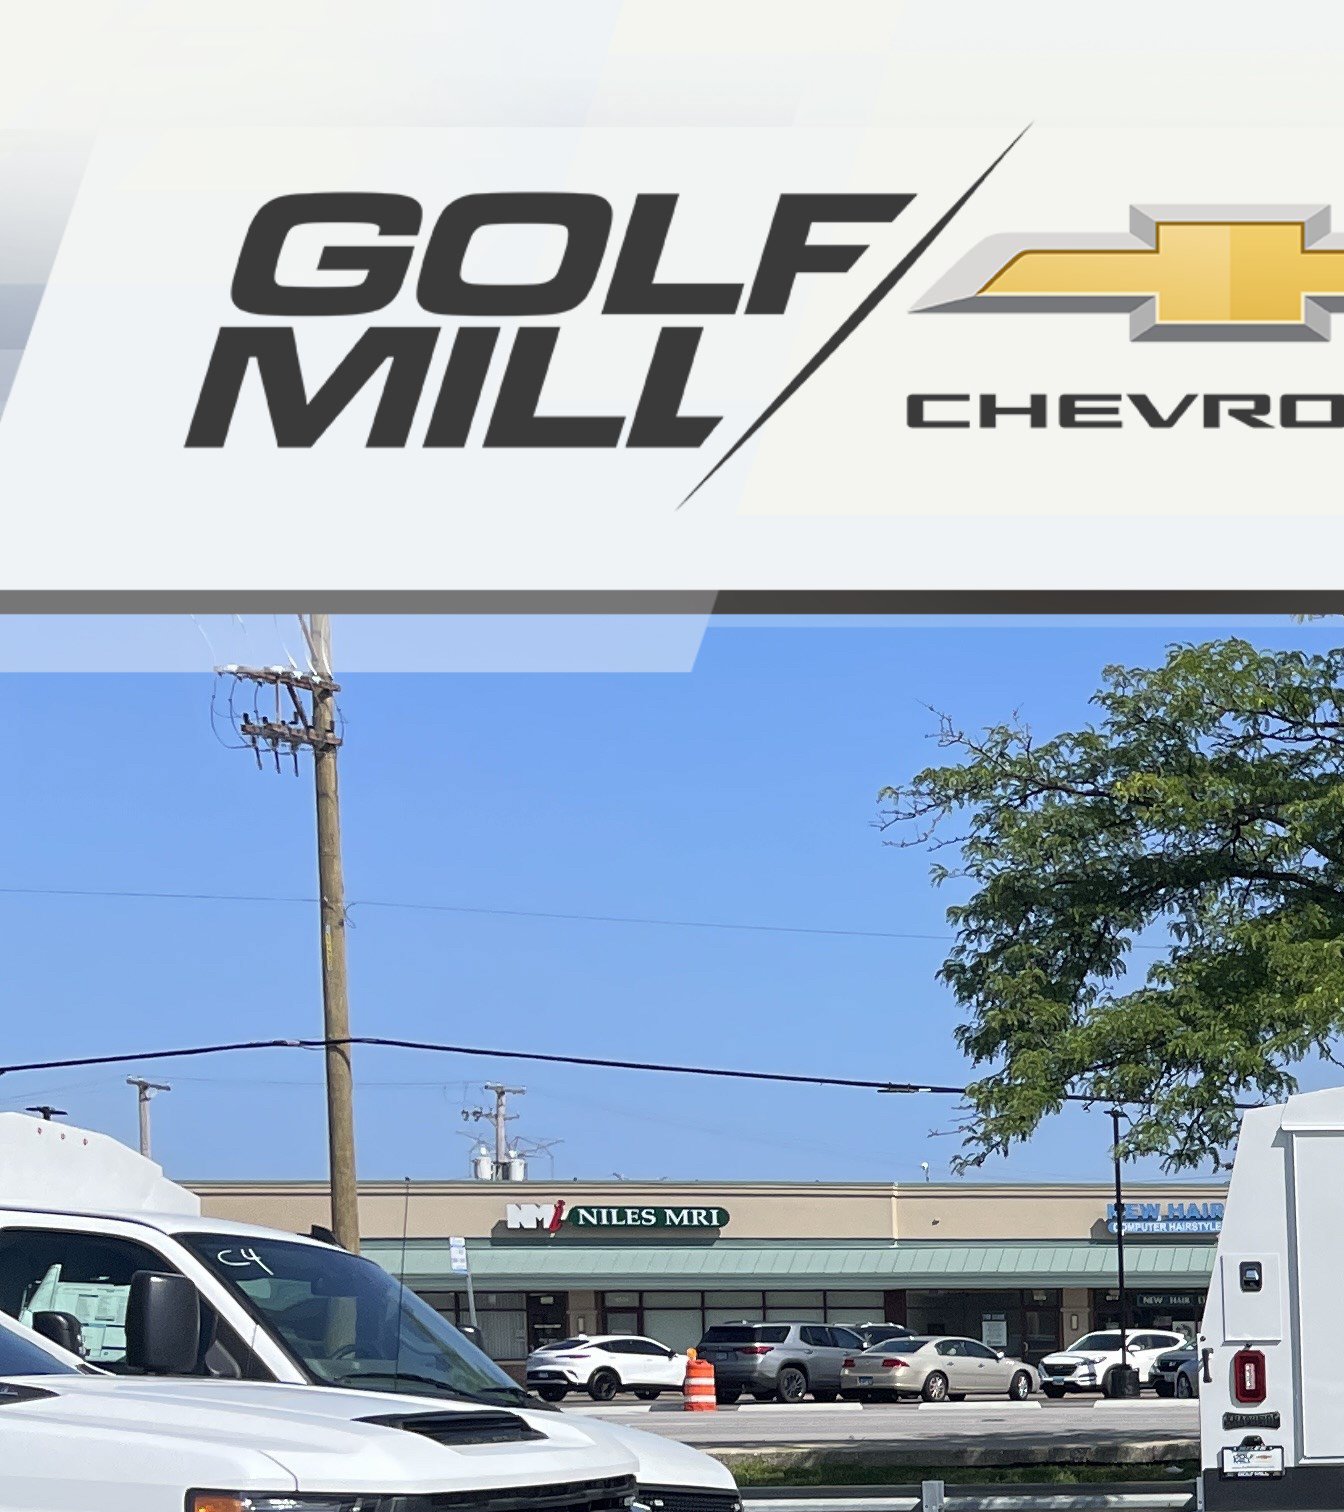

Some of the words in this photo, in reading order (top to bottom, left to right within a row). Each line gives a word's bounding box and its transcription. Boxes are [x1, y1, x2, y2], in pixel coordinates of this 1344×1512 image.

[577, 1208, 658, 1226] NILES
[663, 1208, 721, 1226] MRI
[217, 1248, 274, 1276] C4
